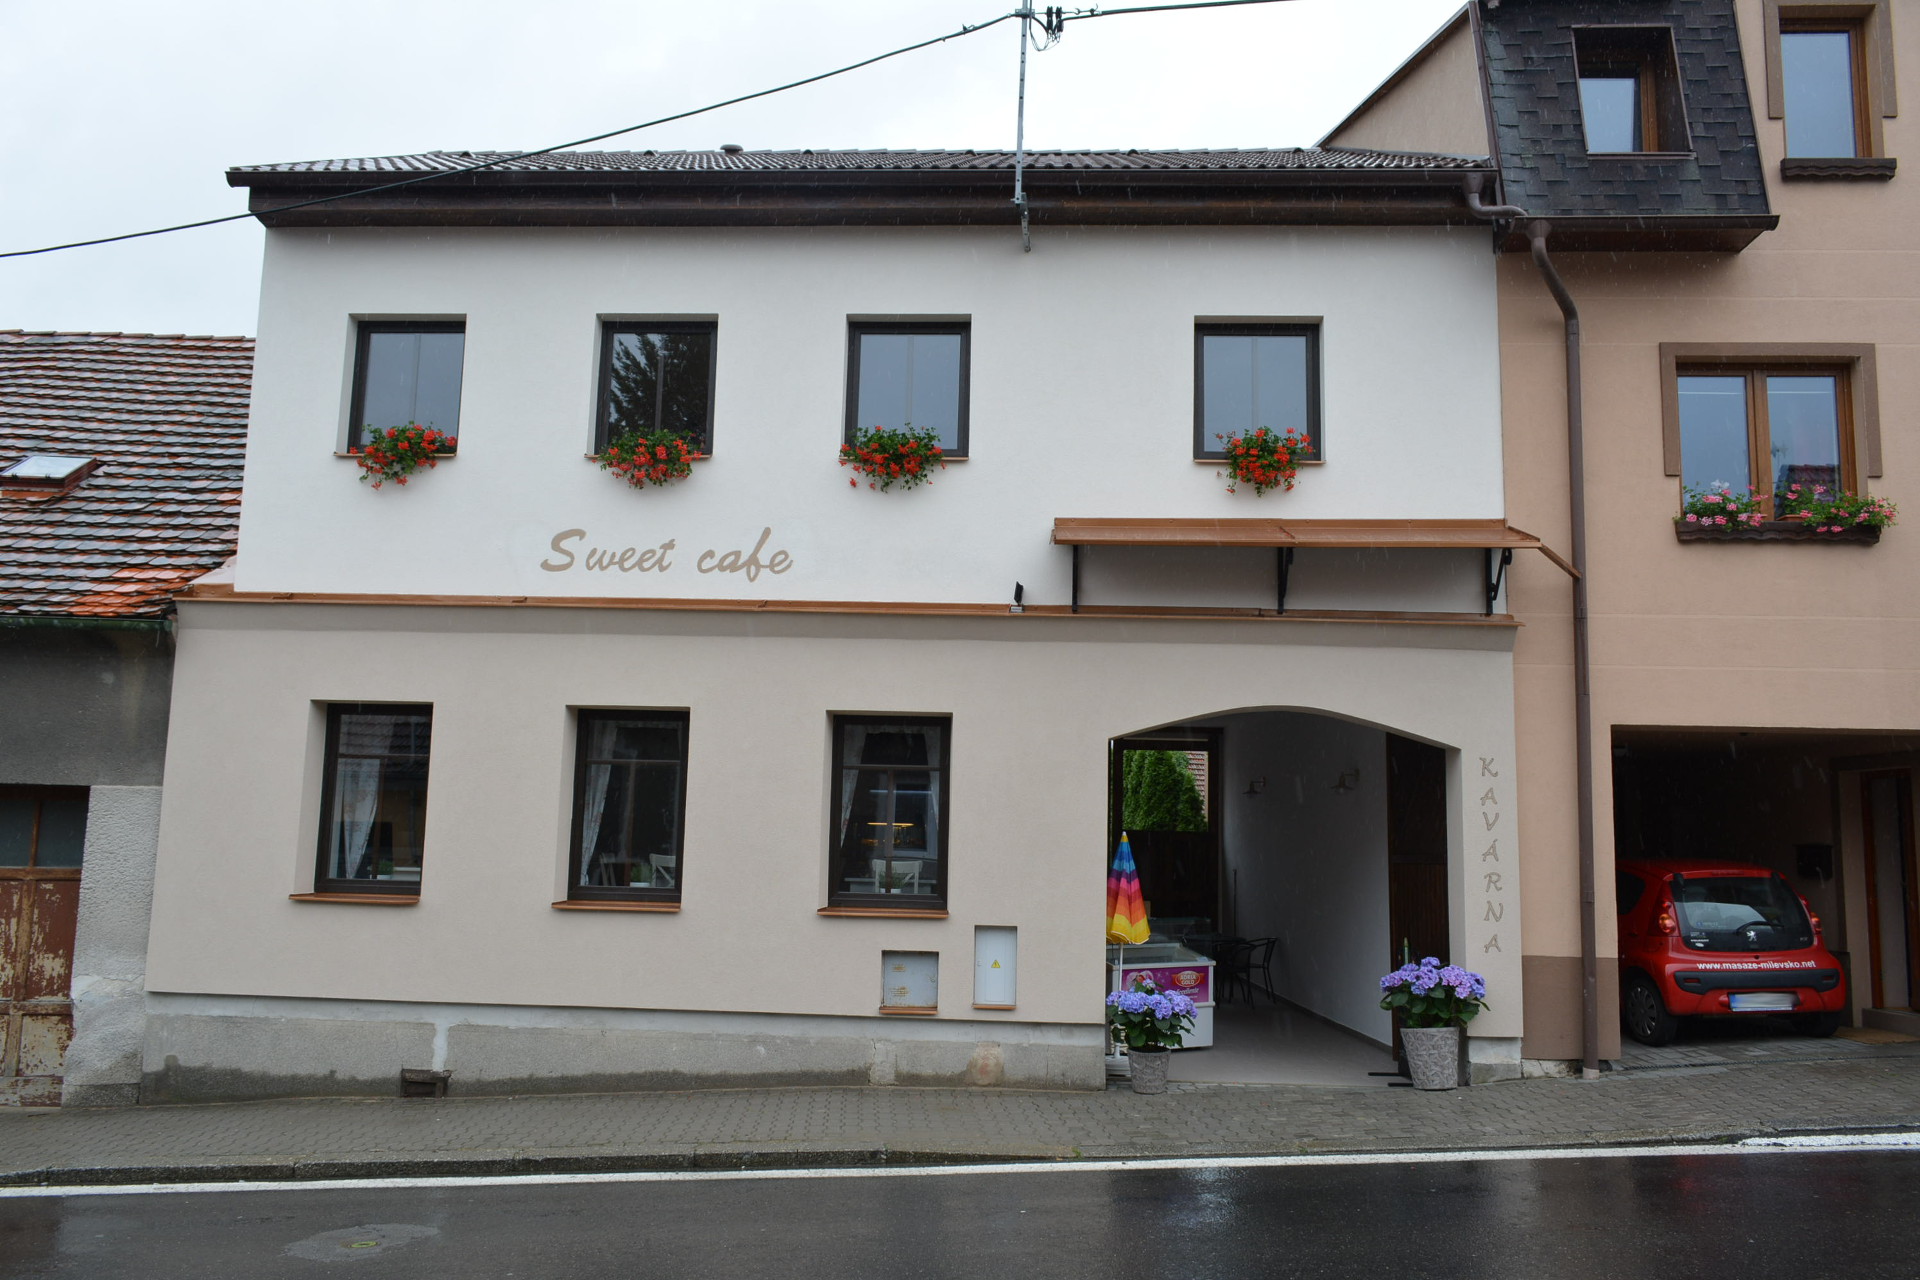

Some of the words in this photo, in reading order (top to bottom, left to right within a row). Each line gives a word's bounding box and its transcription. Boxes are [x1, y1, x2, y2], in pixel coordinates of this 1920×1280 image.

[540, 528, 676, 573] Sweet
[696, 526, 794, 583] cafe
[1696, 960, 1817, 970] www.masaze-milevsko.net
